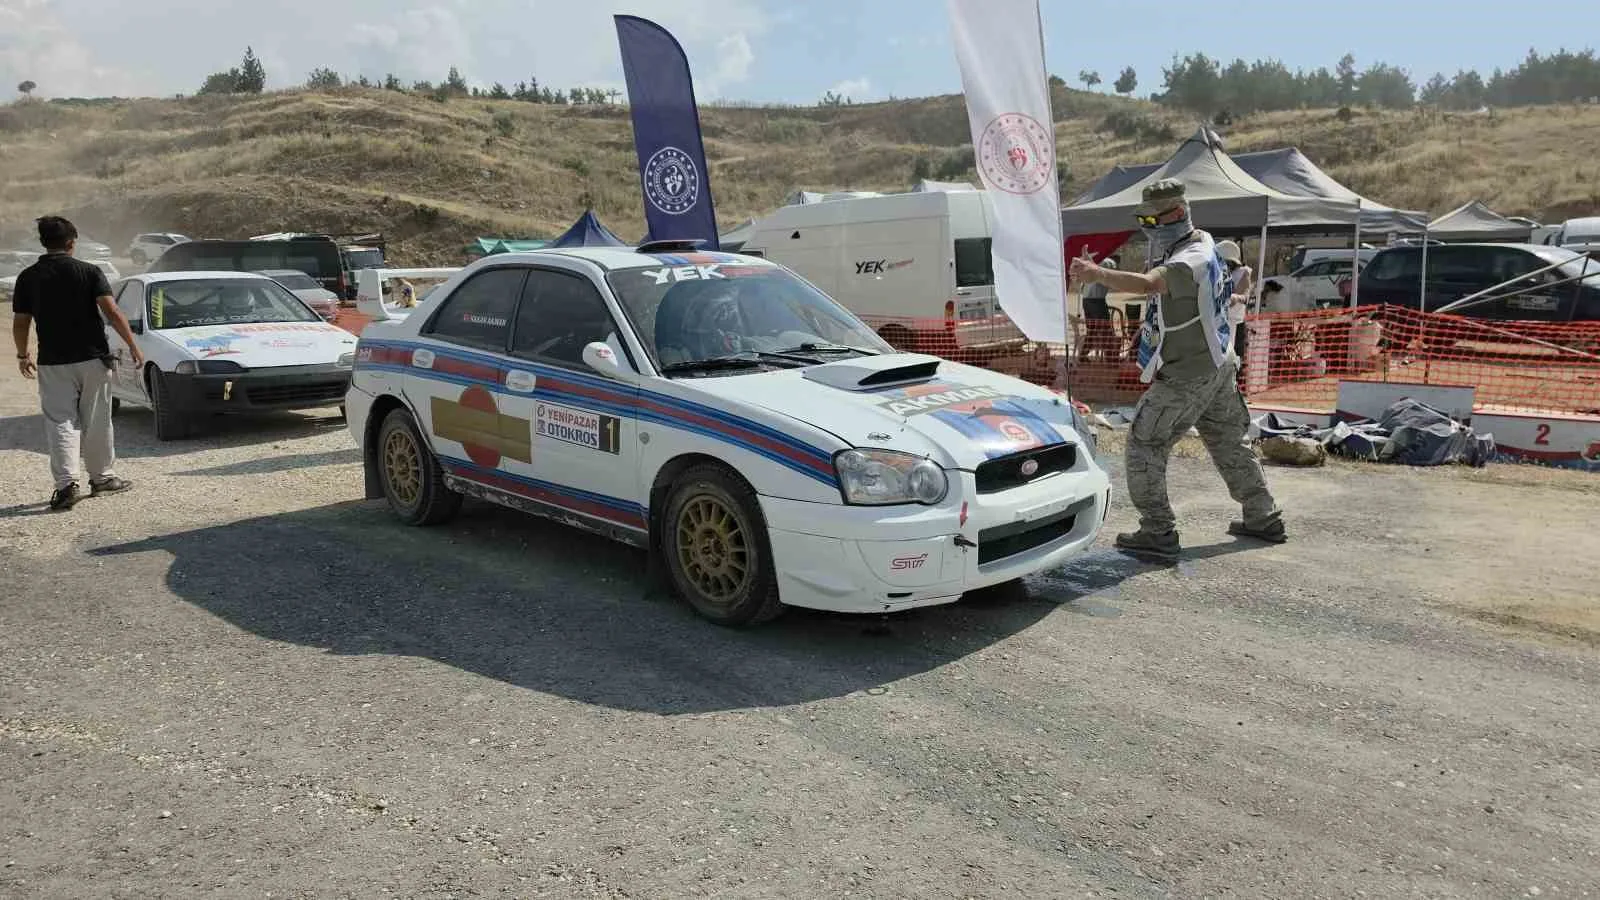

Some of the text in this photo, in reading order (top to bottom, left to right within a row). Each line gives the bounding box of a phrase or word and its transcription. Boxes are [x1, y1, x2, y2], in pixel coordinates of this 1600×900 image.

[641, 263, 727, 285] YEK
[855, 259, 886, 274] YEK
[890, 386, 999, 415] AKMAN
[547, 406, 598, 430] YENİPAZAR
[547, 422, 598, 446] OTOKROS
[606, 418, 615, 453] 1
[1534, 423, 1551, 446] 2
